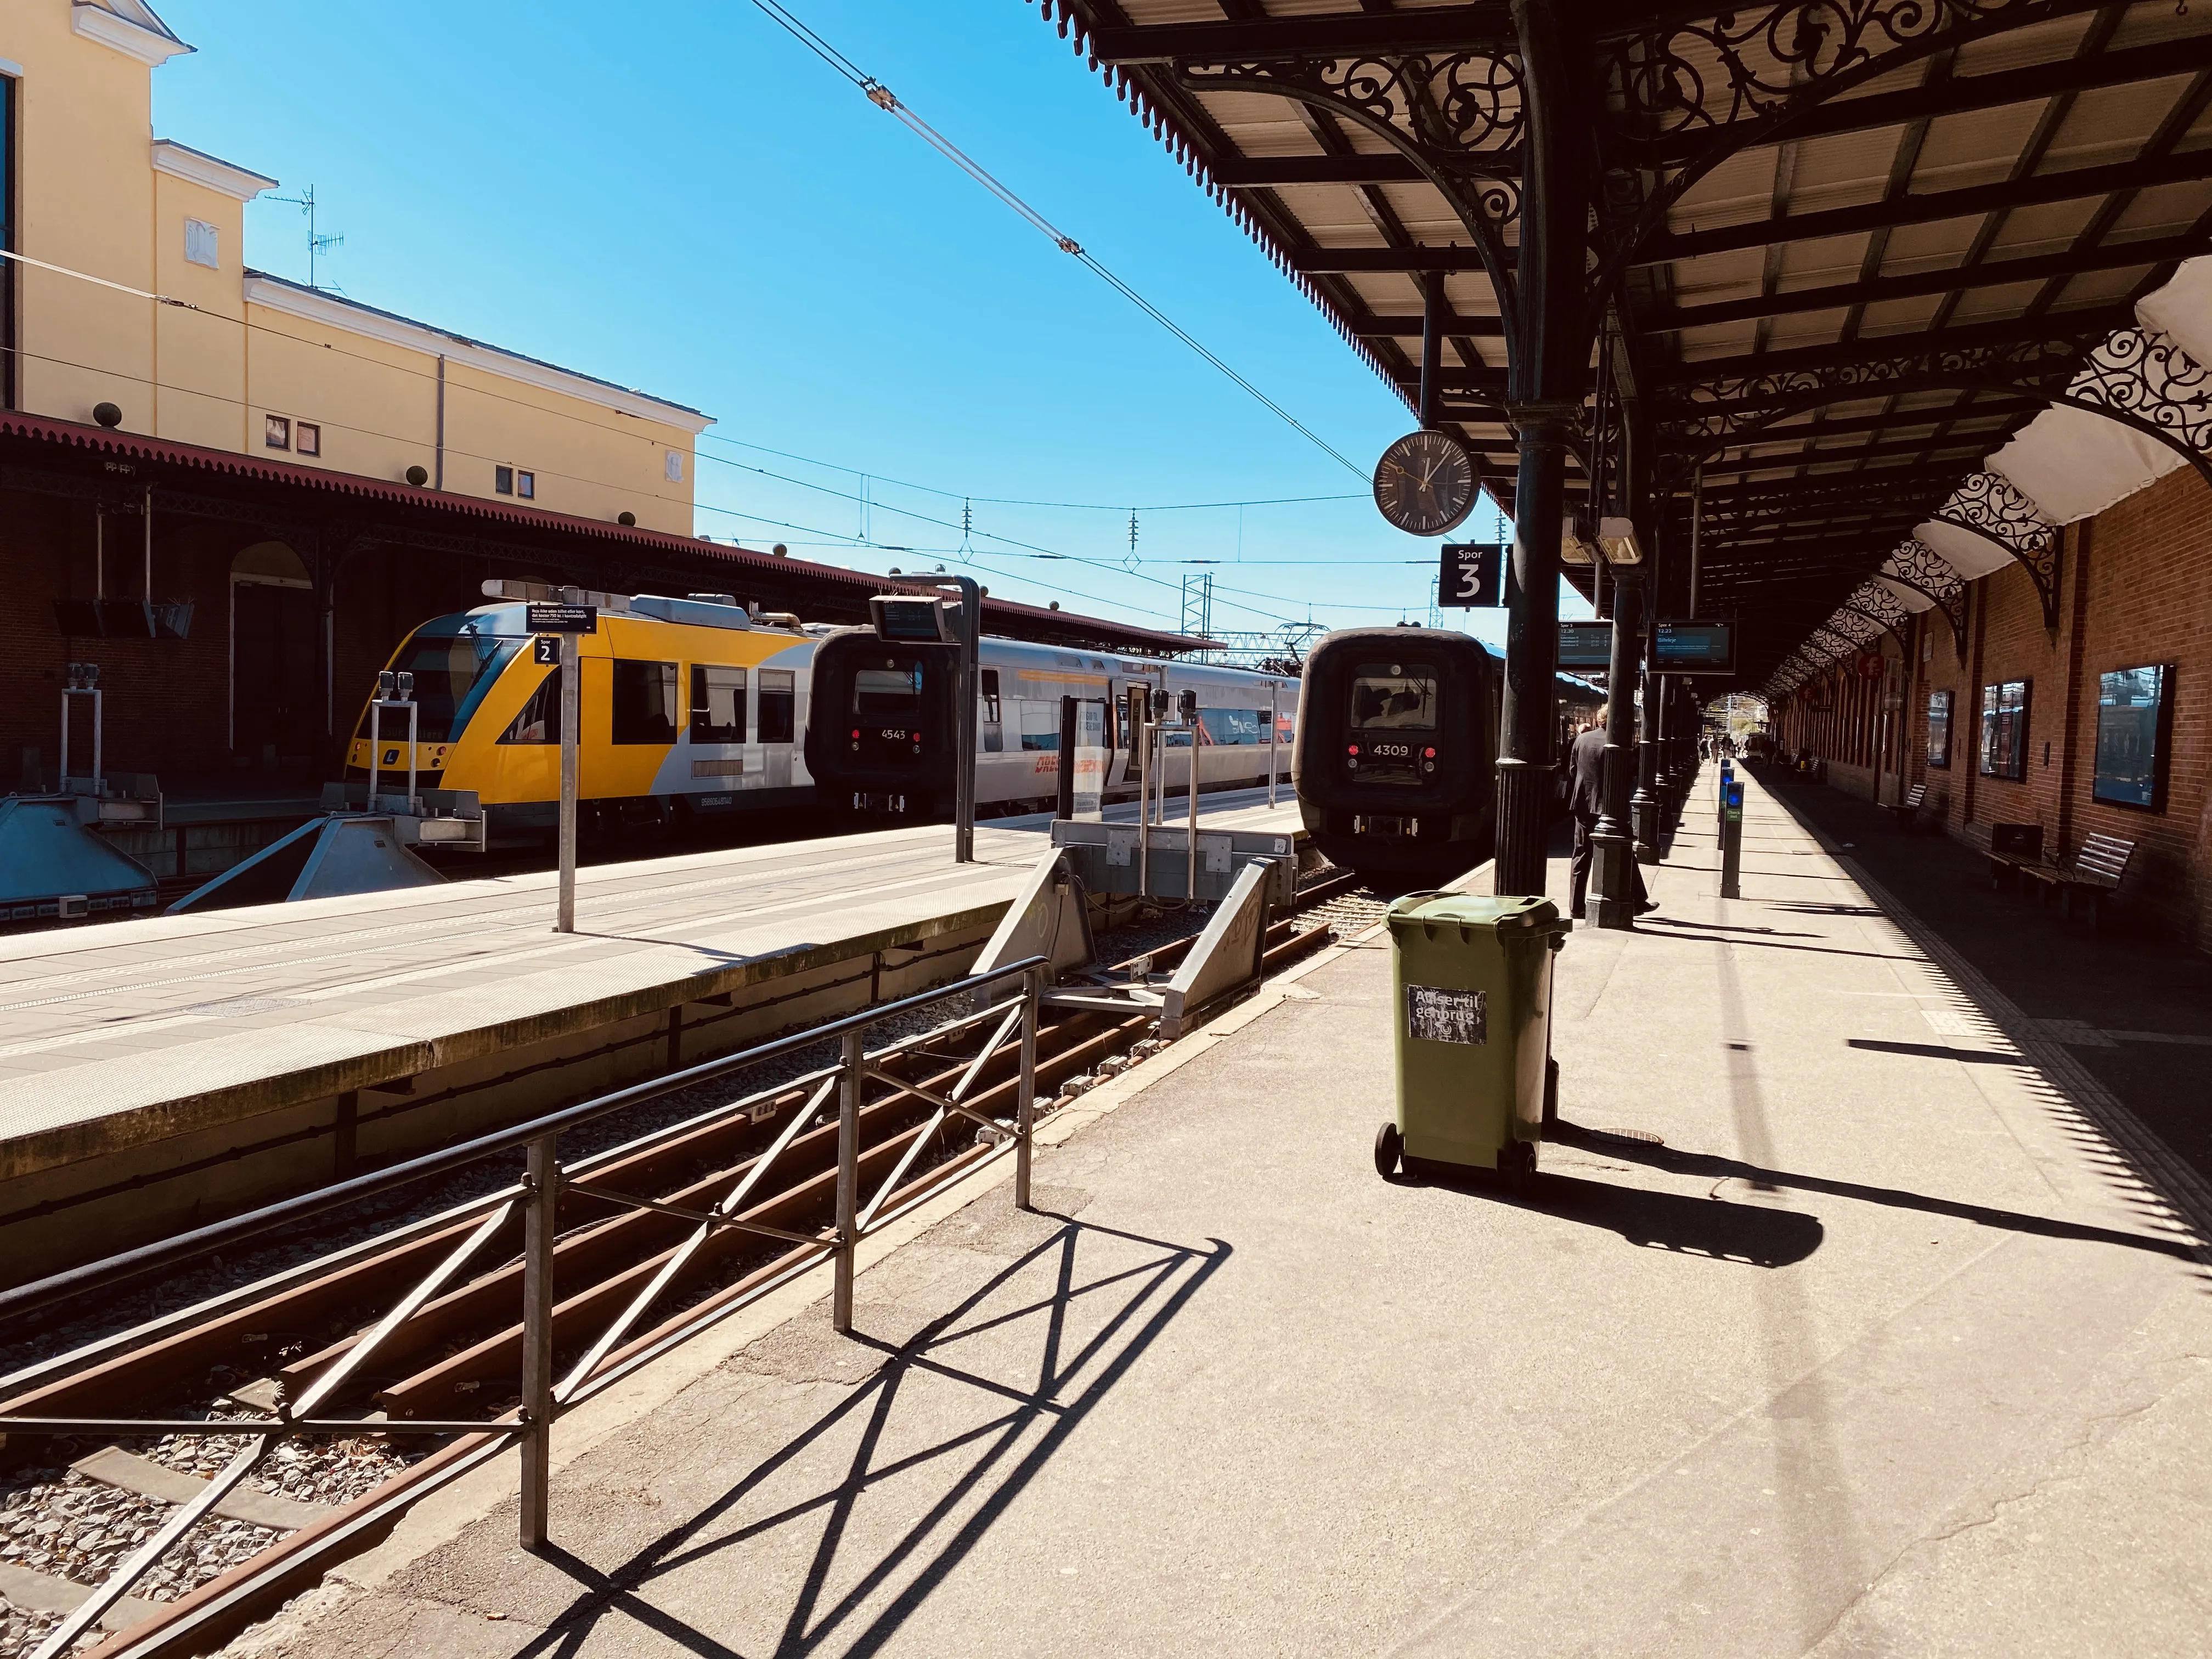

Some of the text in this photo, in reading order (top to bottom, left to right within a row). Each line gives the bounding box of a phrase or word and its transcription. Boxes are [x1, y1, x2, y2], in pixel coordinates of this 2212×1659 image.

[1458, 550, 1483, 561] Spor
[1456, 563, 1480, 598] 3
[540, 646, 550, 661] 2
[882, 729, 905, 740] 4543
[1374, 744, 1408, 756] 4309
